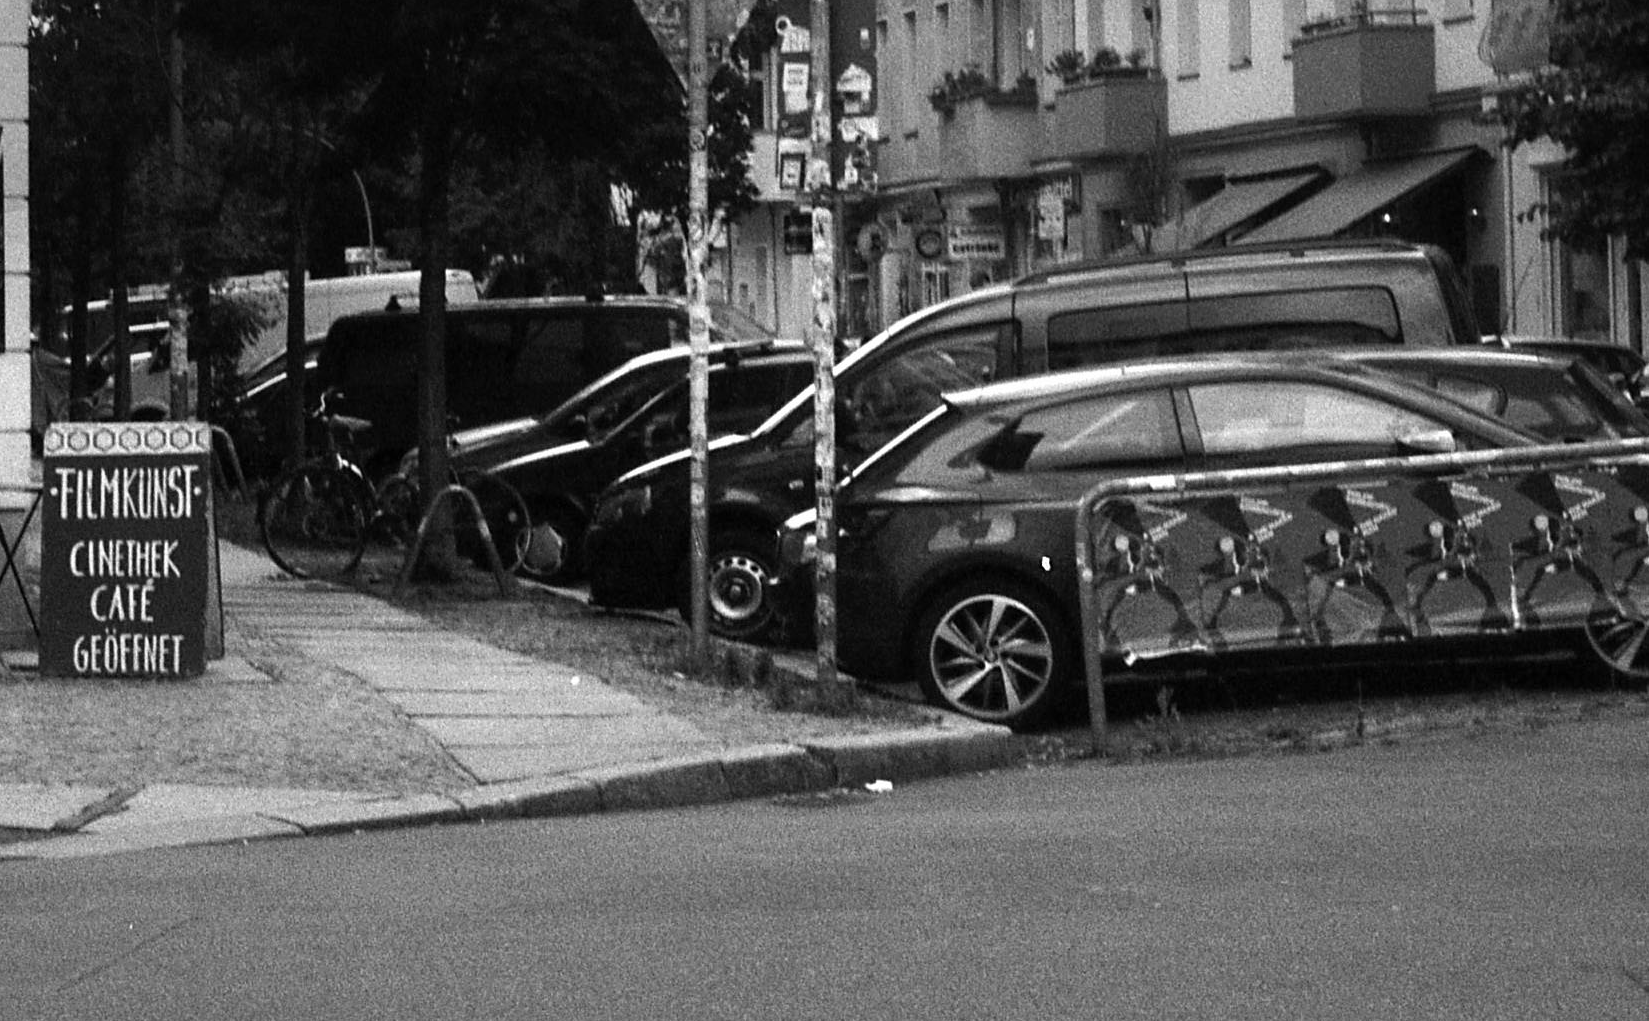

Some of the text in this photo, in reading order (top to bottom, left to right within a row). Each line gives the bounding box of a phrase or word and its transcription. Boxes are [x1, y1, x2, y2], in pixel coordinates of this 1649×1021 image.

[55, 464, 200, 520] FILMKUNST
[69, 539, 181, 578] CINETHEK
[89, 577, 155, 623] CAFÉ
[72, 627, 185, 674] GEÖFFNET
